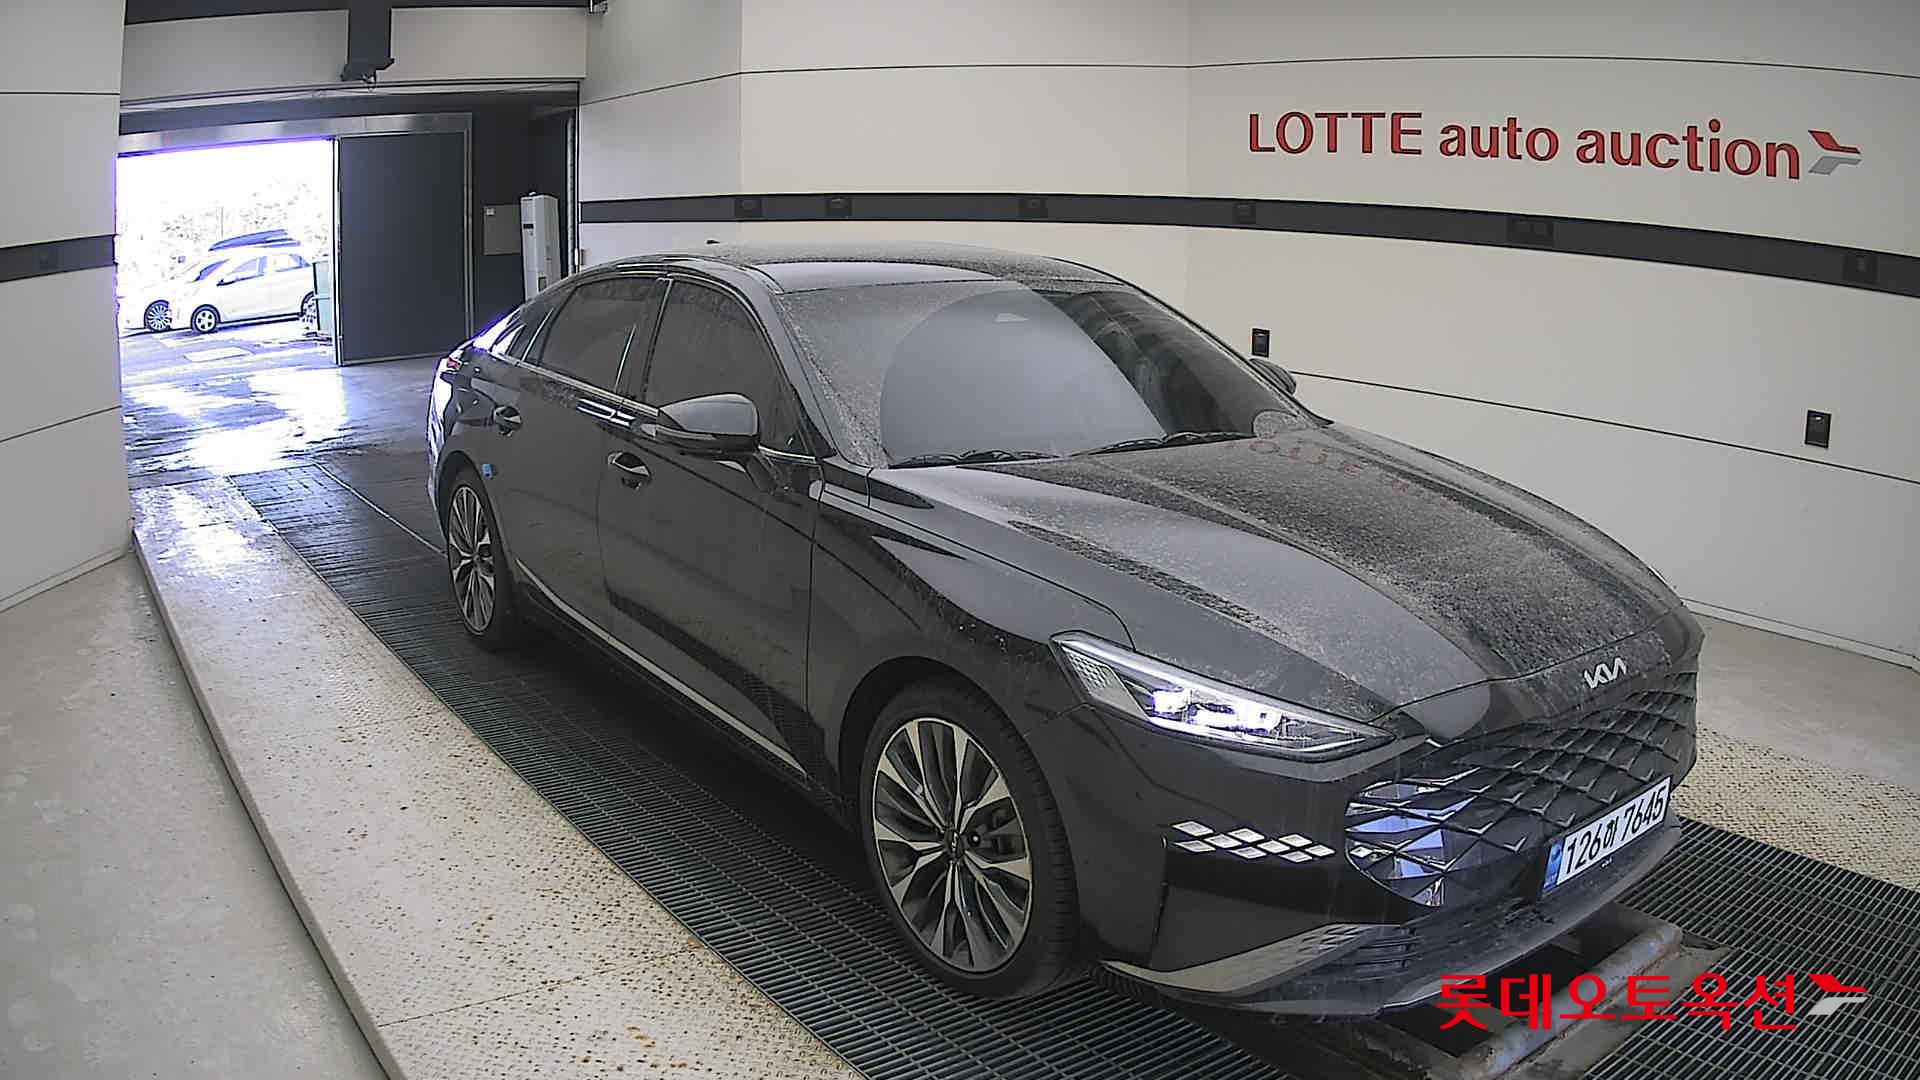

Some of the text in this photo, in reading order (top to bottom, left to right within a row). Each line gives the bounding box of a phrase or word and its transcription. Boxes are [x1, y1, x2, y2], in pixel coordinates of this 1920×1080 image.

[1248, 112, 1801, 180] LOTTE auto auction
[1621, 786, 1667, 841] 7645
